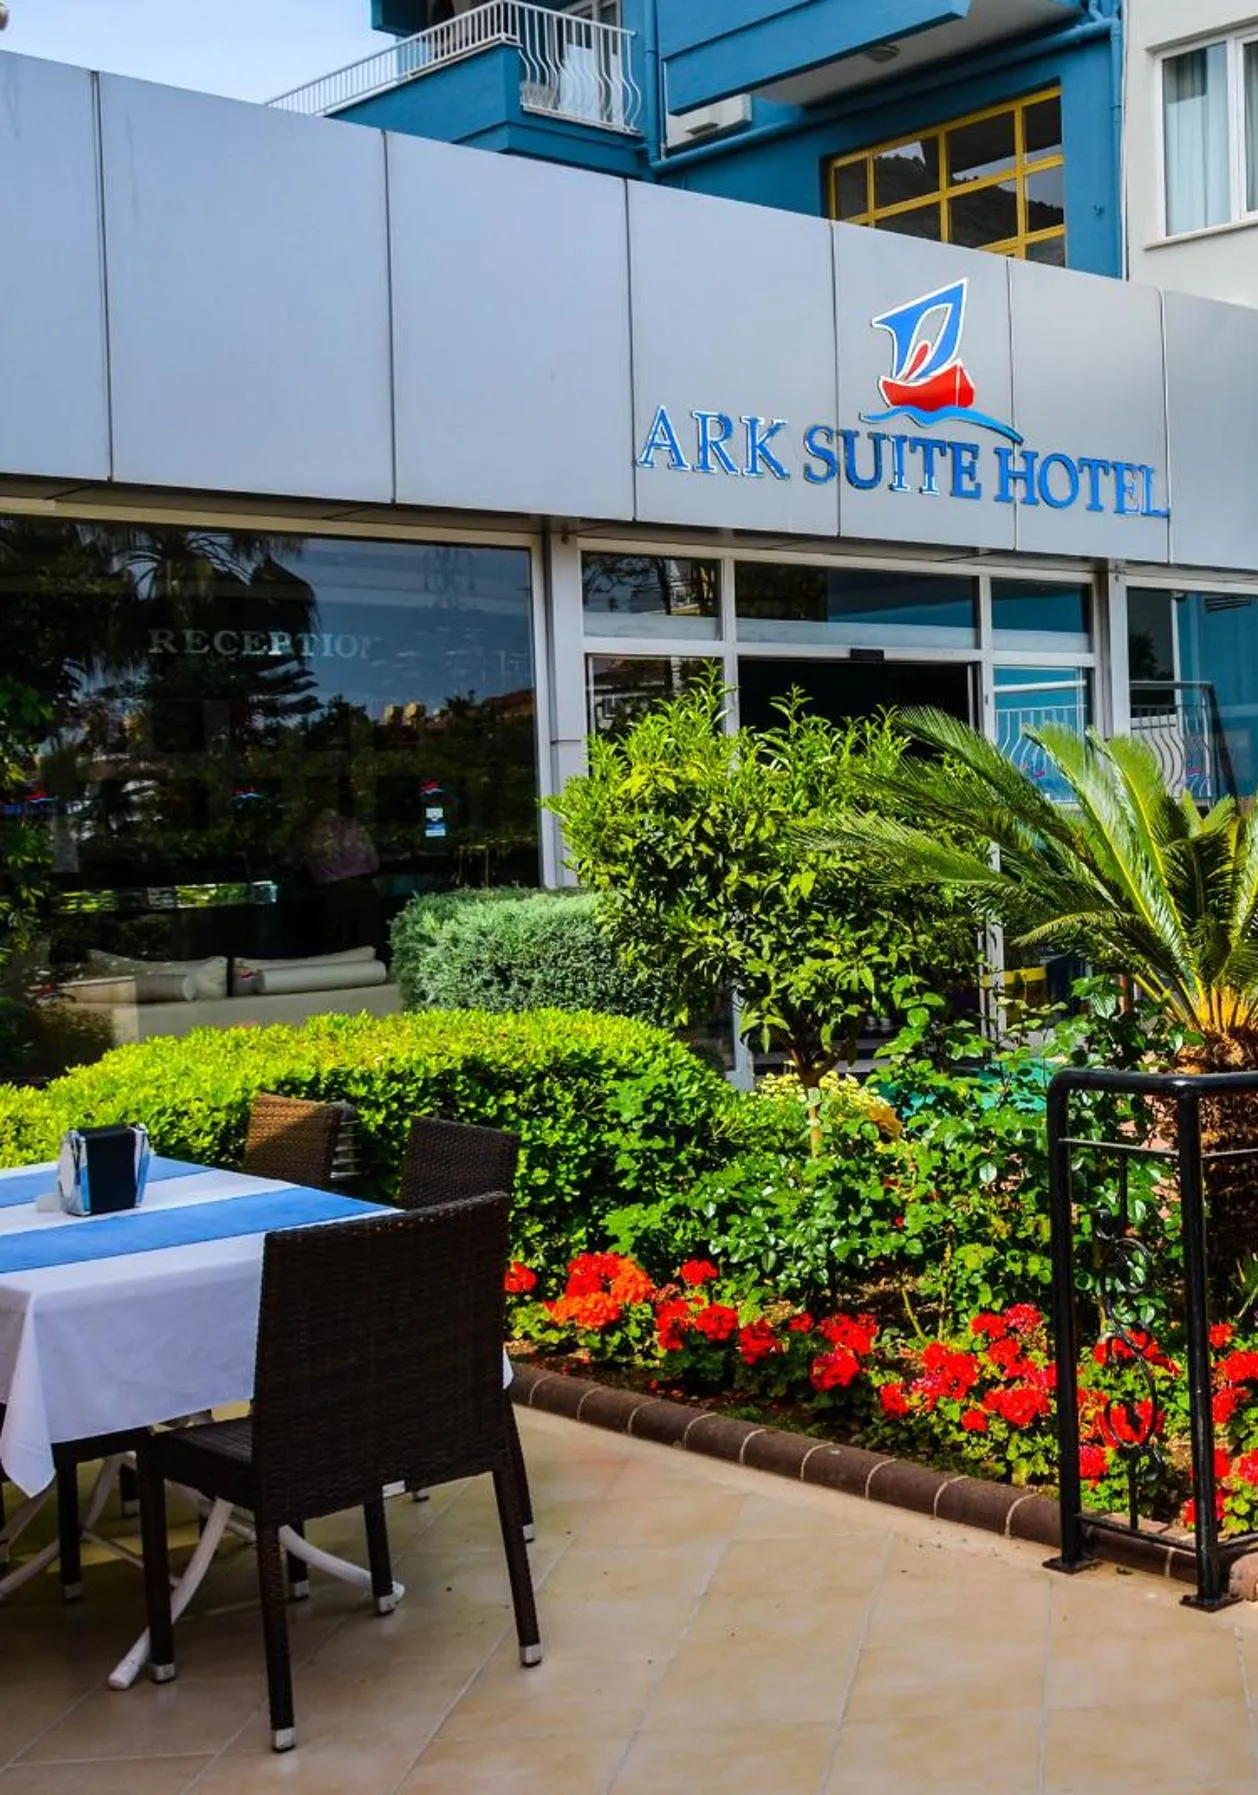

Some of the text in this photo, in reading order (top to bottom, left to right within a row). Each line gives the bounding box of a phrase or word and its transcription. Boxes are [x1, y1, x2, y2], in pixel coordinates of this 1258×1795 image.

[637, 404, 1171, 519] ARK SUITE HOTEL
